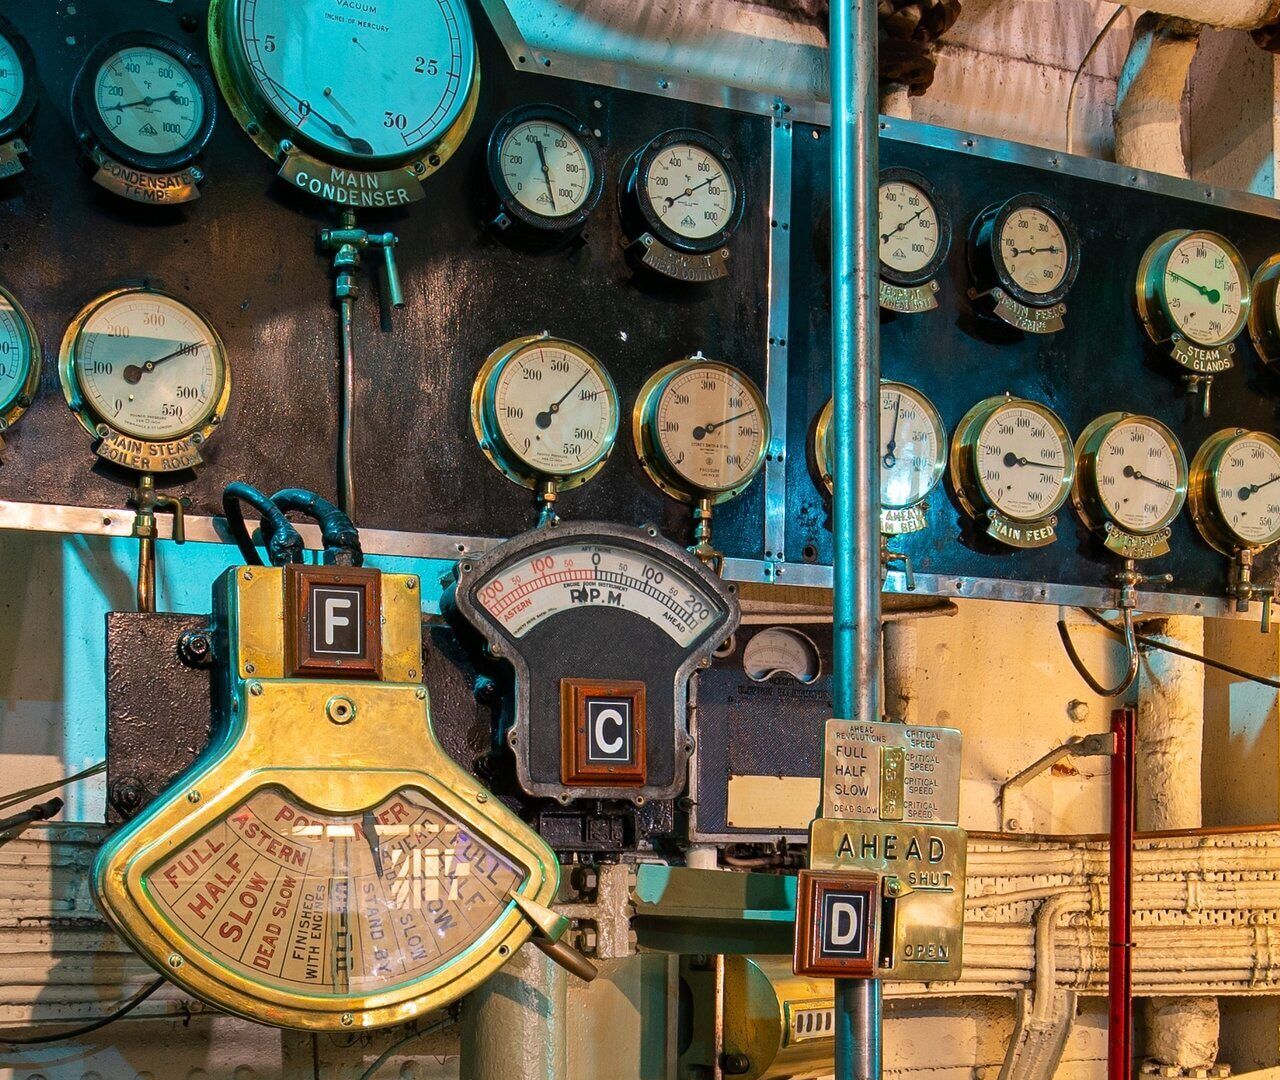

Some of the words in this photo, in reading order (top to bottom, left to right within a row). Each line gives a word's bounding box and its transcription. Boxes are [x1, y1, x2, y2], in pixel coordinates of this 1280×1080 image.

[324, 13, 346, 23] INCHES
[347, 17, 356, 25] OF
[357, 20, 390, 33] MERCURY
[264, 34, 276, 53] 5
[415, 56, 439, 76] 25
[383, 111, 408, 131] 30
[295, 171, 411, 207] CONDENSER
[330, 168, 379, 190] MAIN
[1174, 349, 1188, 363] TO
[1192, 359, 1231, 372] GLANDS
[1186, 345, 1220, 361] STEAM
[176, 386, 198, 399] 500
[162, 404, 183, 417] 550
[991, 518, 1022, 541] MAIN
[1026, 526, 1055, 542] FEED
[531, 555, 555, 574] 100
[591, 552, 602, 566] 0
[641, 564, 665, 585] 100
[480, 578, 505, 605] 200
[503, 598, 533, 622] ASTERN
[684, 593, 710, 621] 200
[324, 597, 351, 645] F
[662, 611, 686, 633] AHEAD
[594, 708, 624, 753] C
[836, 732, 888, 743] REVOLUTIONS
[849, 724, 875, 734] AHEAD
[906, 729, 942, 741] CRITICAL
[836, 746, 868, 759] FULL
[910, 738, 937, 749] SPEED
[905, 753, 940, 764] CRITICAL
[909, 761, 935, 772] SPEED
[835, 764, 867, 778] HALF
[834, 784, 869, 796] SLOW
[904, 777, 939, 788] CRITICAL
[908, 785, 934, 795] SPEED
[834, 804, 856, 813] DEAD
[857, 804, 879, 815] SLOW
[903, 800, 939, 812] CRITICAL
[907, 808, 934, 819] SPEED
[232, 813, 307, 868] ASTERN
[836, 833, 947, 864] AHEAD
[163, 838, 226, 890] FULL
[186, 852, 242, 920] HALF
[908, 872, 953, 887] SHUT
[219, 870, 269, 944] SLOW
[311, 884, 326, 943] ENGINES
[252, 922, 282, 971] DEAD
[272, 874, 298, 919] SLOW
[292, 893, 315, 962] FINISHED
[363, 882, 385, 941] STAND
[374, 949, 392, 973] BY
[830, 901, 859, 945] D
[400, 912, 428, 961] SLOW
[305, 943, 320, 980] WITH
[904, 943, 950, 960] OPEN
